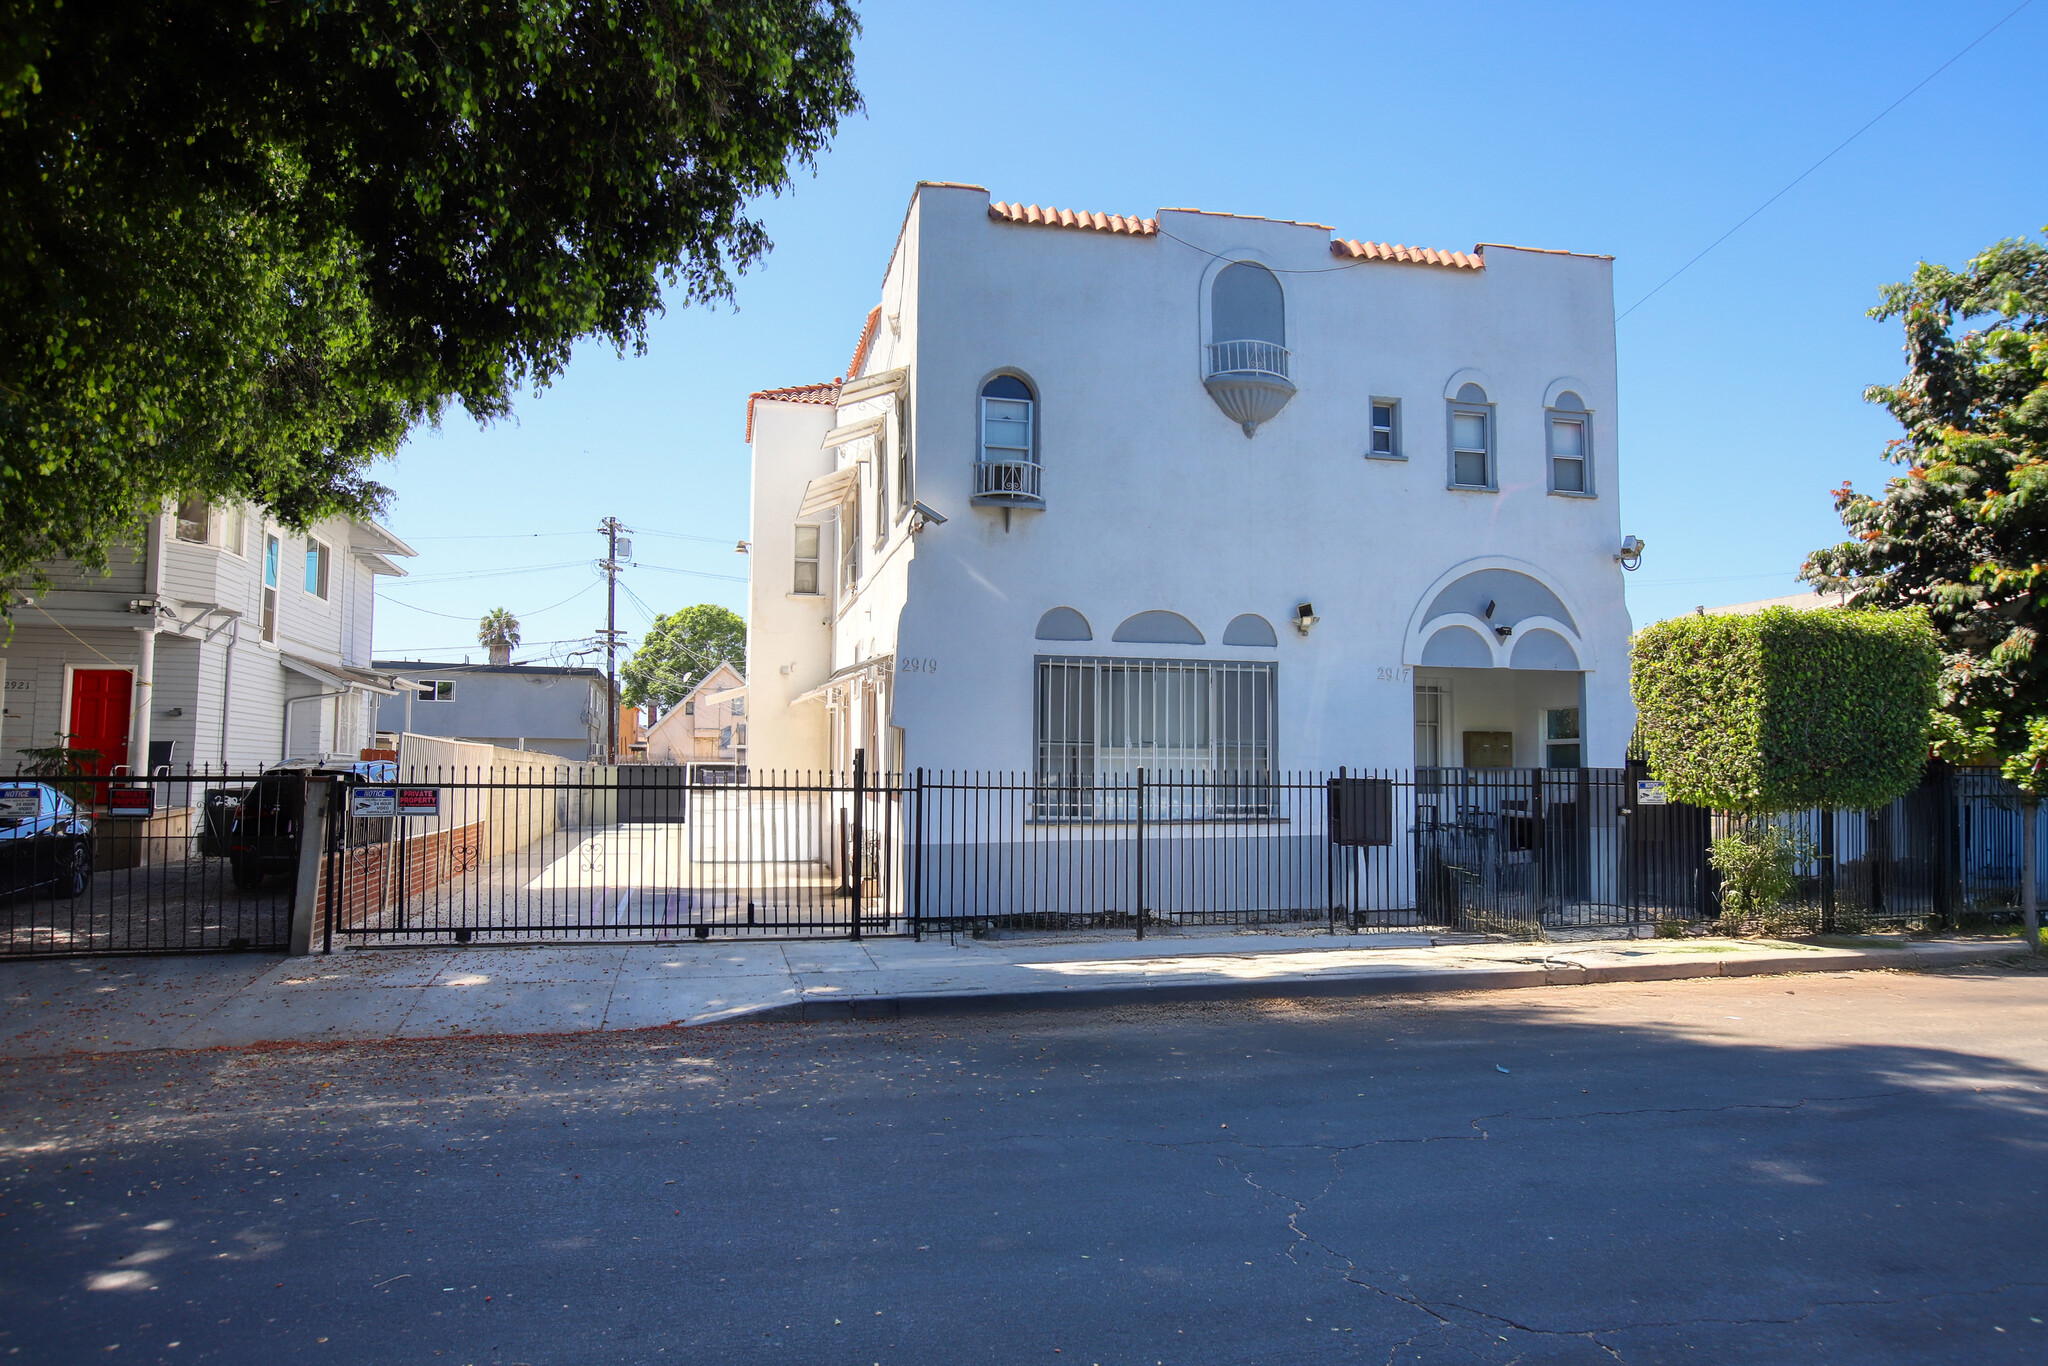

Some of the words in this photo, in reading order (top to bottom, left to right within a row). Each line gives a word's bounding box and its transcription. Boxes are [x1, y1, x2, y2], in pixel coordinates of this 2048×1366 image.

[902, 657, 937, 673] 2919
[1377, 666, 1411, 683] 2917
[4, 681, 30, 690] 2921
[4, 790, 30, 798] NOTICE
